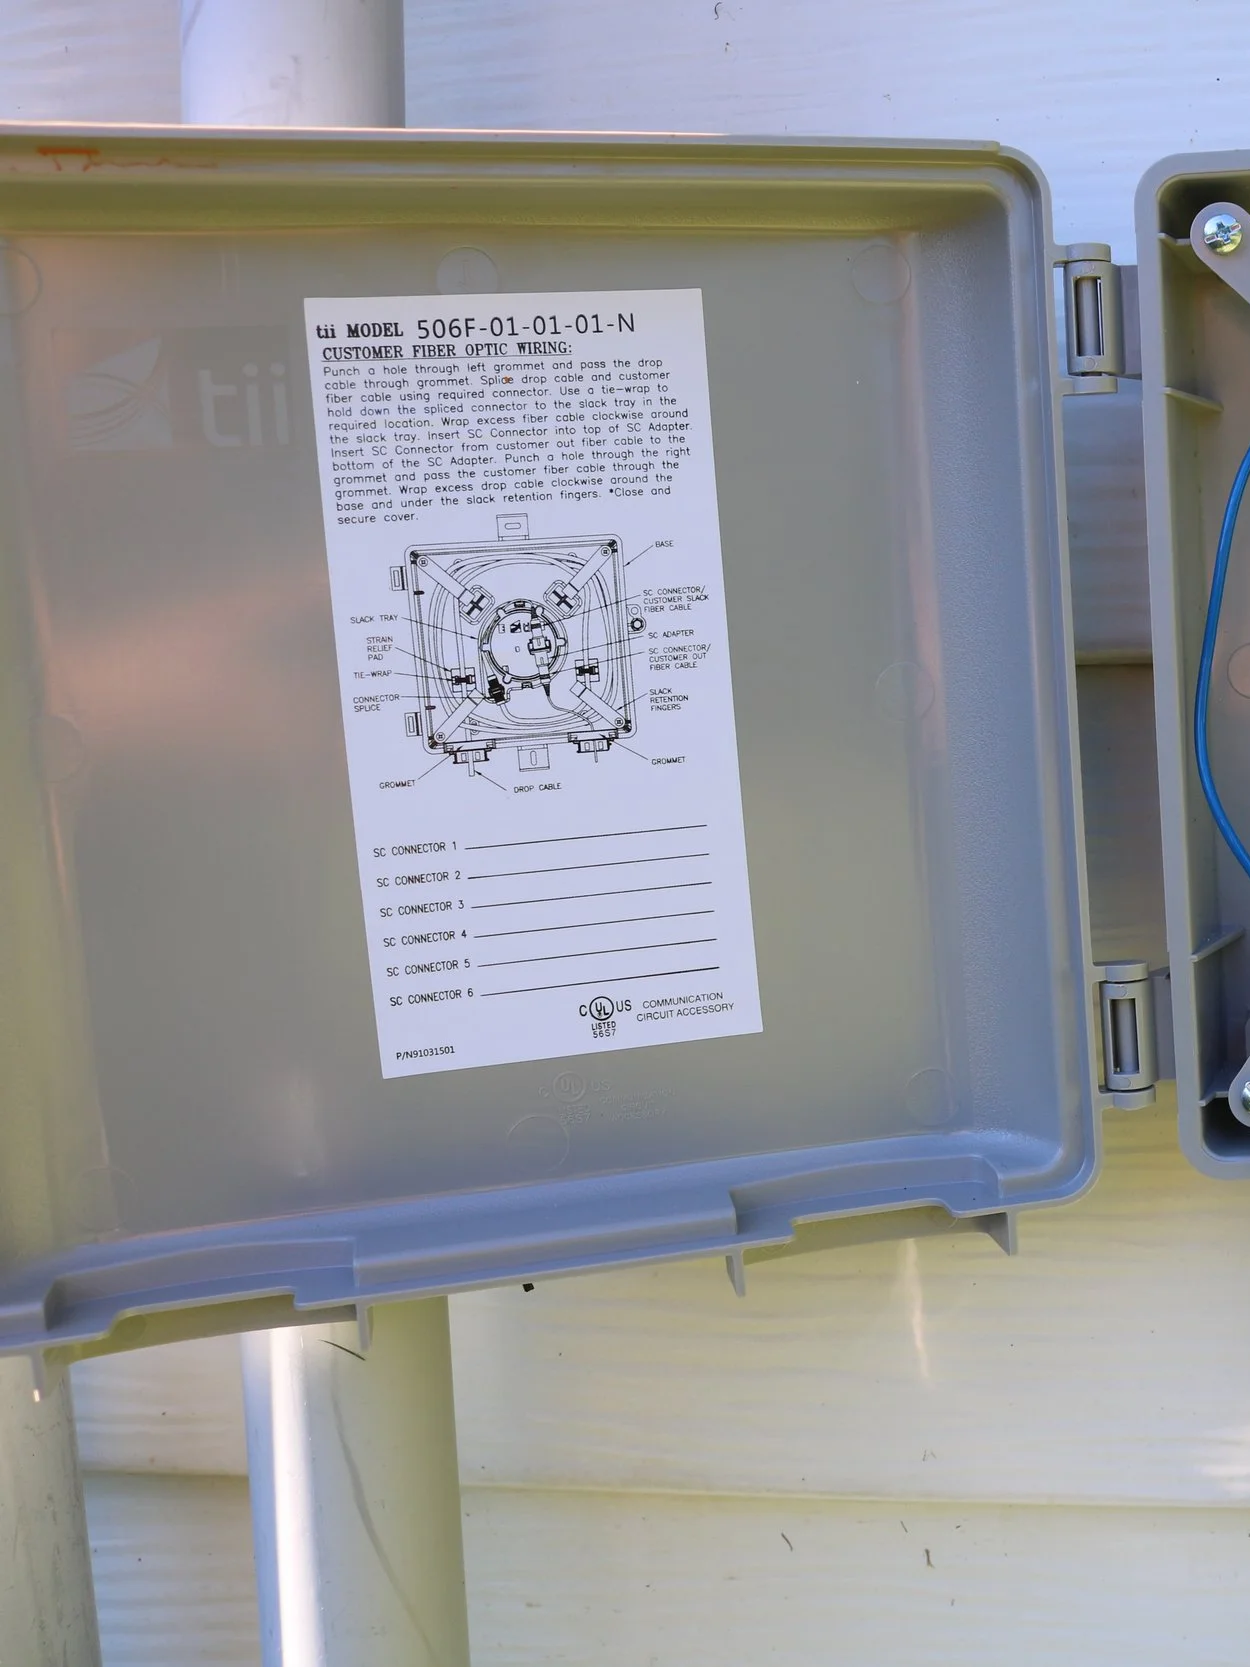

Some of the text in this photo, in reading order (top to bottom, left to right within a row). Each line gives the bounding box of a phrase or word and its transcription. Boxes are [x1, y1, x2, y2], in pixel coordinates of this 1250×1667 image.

[315, 312, 634, 339] tii MODEL 506F-01-01-01-N
[321, 340, 572, 360] CUSTOMER FIBER OPTIC WIRING:
[322, 357, 663, 376] Punch a hole through left grommet and pass the drop
[324, 370, 671, 390] cable through grommet. Splice drop cable and customer
[197, 362, 290, 447] tii
[326, 395, 676, 417] hold down the spliced connector to the slack tray in the
[328, 407, 688, 432] required location. Wrap excess fiber cable clockwise around
[329, 420, 692, 444] the slack tray. Insert SC Connector into top of SC Adapter.
[332, 446, 691, 471] bottom of the SC Adapter. Punch a hole through the right
[332, 459, 679, 486] grommet and pass the customer fiber cable through the
[335, 501, 364, 511] base
[371, 498, 392, 509] and
[400, 496, 433, 508] under
[440, 495, 458, 505] the
[466, 493, 495, 504] slack
[502, 491, 552, 502] retention
[559, 489, 601, 501] fingers.
[650, 484, 671, 495] and
[336, 512, 418, 524] secure cover.
[655, 540, 674, 548] BASE
[643, 595, 683, 604] CUSTOMER
[644, 603, 692, 613] FIBER CABLE
[350, 616, 375, 624] SLACK
[366, 636, 393, 644] STRAIN
[648, 629, 694, 639] SC ADAPTER
[649, 654, 686, 663] CUSTOMER
[649, 661, 698, 671] FIBER CABLE
[353, 670, 392, 679] TIE-WRAP
[353, 694, 400, 703] CONNECTOR
[650, 695, 689, 704] RETENTION
[354, 704, 381, 712] SPLICE
[650, 703, 681, 711] FINGERS
[651, 756, 686, 765] GROMMET
[379, 779, 416, 789] GROMMET
[513, 783, 562, 793] DROP CABLE
[373, 847, 386, 858] SC
[391, 842, 446, 856] CONNECTOR
[376, 870, 461, 888] SC CONNECTOR 2
[379, 900, 465, 918] SC CONNECTOR 3
[383, 930, 467, 947] SC CONNECTOR 4
[386, 959, 471, 977] SC CONNECTOR 5
[389, 988, 474, 1007] SC CONNECTOR 6
[642, 992, 724, 1009] COMMUNICATION
[615, 999, 632, 1013] US
[636, 1002, 734, 1022] CIRCUIT ACCESSORY
[591, 1021, 617, 1031] LISTED
[395, 1045, 456, 1060] P/N91031501
